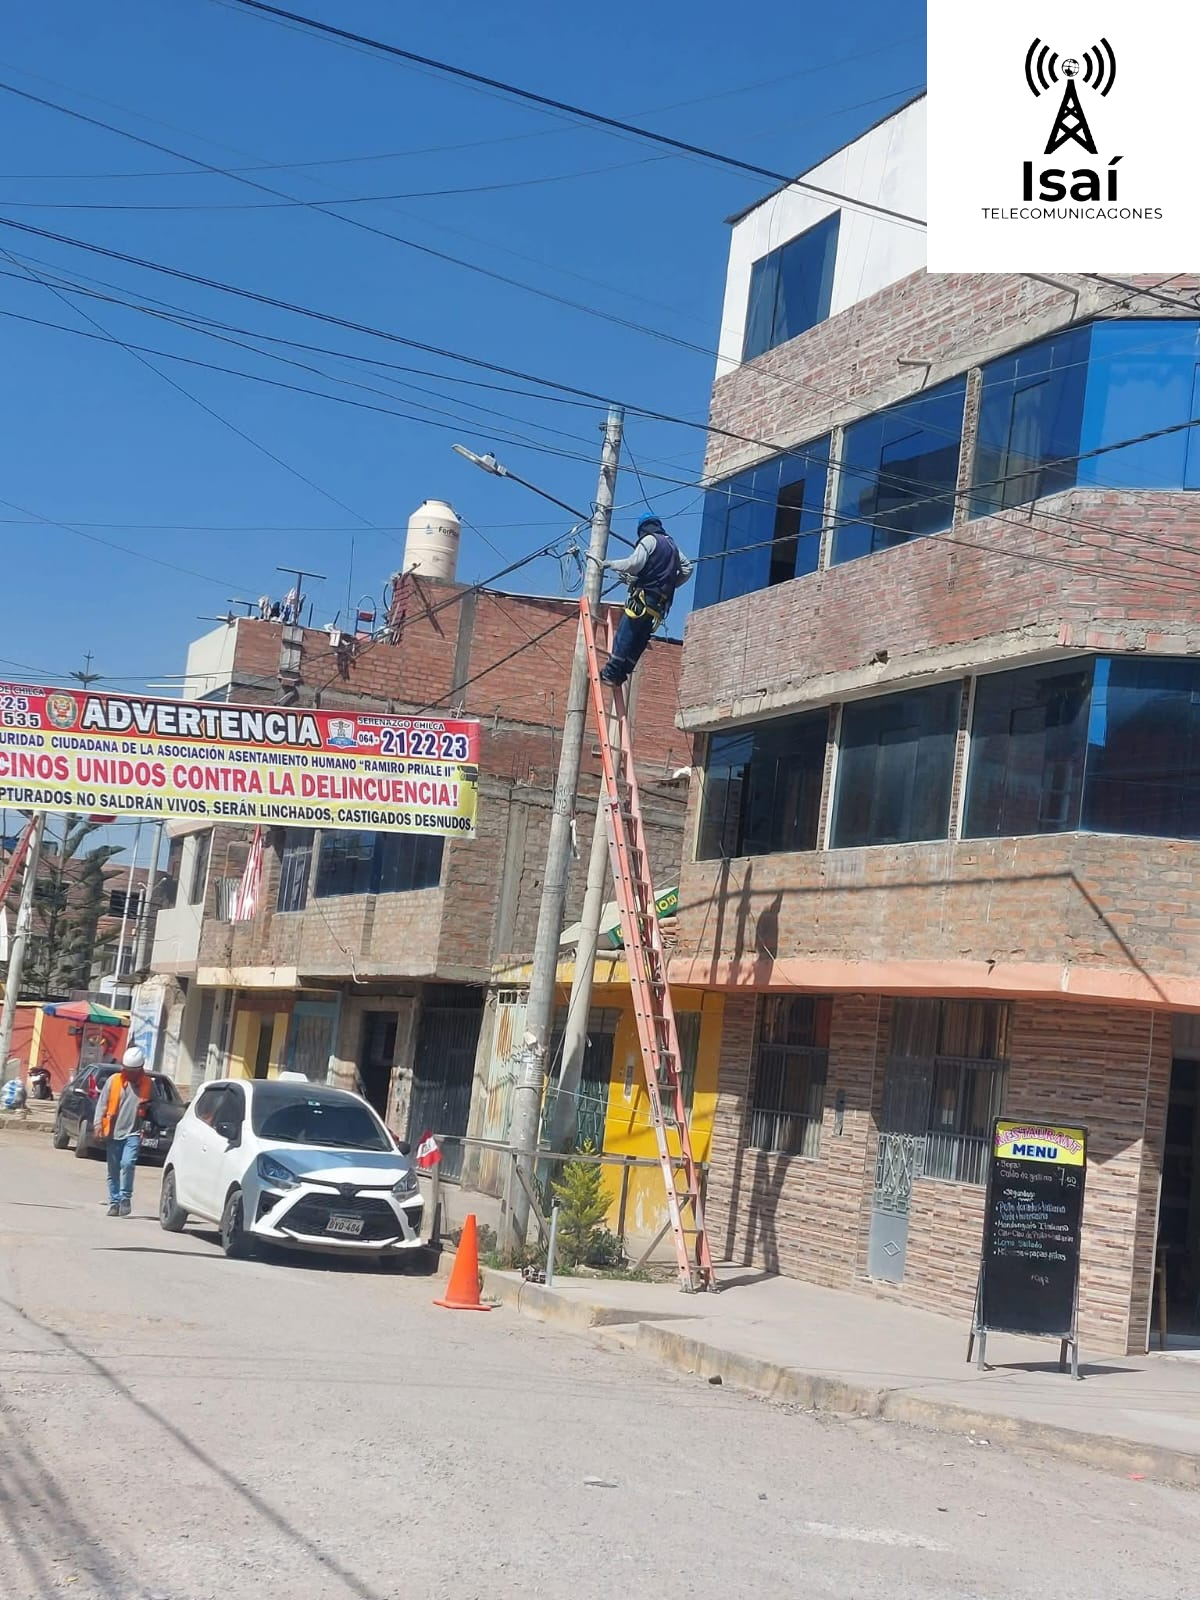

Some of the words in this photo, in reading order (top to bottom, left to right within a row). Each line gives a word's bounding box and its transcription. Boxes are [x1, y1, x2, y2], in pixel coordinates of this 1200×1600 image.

[14, 686, 45, 696] CHILCA
[82, 697, 321, 746] ADVERTENCIA
[358, 717, 410, 728] SERENAZGO
[414, 721, 445, 731] CHILCA
[0, 732, 44, 747] URIDAD
[51, 736, 118, 752] CIUDADANA
[122, 742, 137, 754] DE
[140, 743, 154, 756] LA
[157, 745, 225, 761] ASOCIACIÓN
[228, 750, 308, 767] ASENTAMIENTO
[311, 754, 357, 770] HUMANO
[407, 763, 442, 776] PRIALE
[0, 751, 70, 781] CINOS
[77, 757, 166, 788] UNIDOS
[173, 764, 262, 795] CONTRA
[269, 771, 295, 797] LA
[301, 773, 458, 807] DELINCUENCIA!
[0, 786, 72, 805] PTURADOS
[77, 792, 96, 807] NO
[100, 792, 163, 811] SALDRÁN
[167, 797, 210, 817] VIVOS,
[213, 799, 256, 817] SERÁN
[260, 803, 335, 824] LINCHADOS,
[338, 808, 412, 827] CASTIGADOS
[414, 812, 474, 832] DESNUDOS.
[995, 1126, 1082, 1155] RESTAURANT
[1012, 1143, 1058, 1159] MENU
